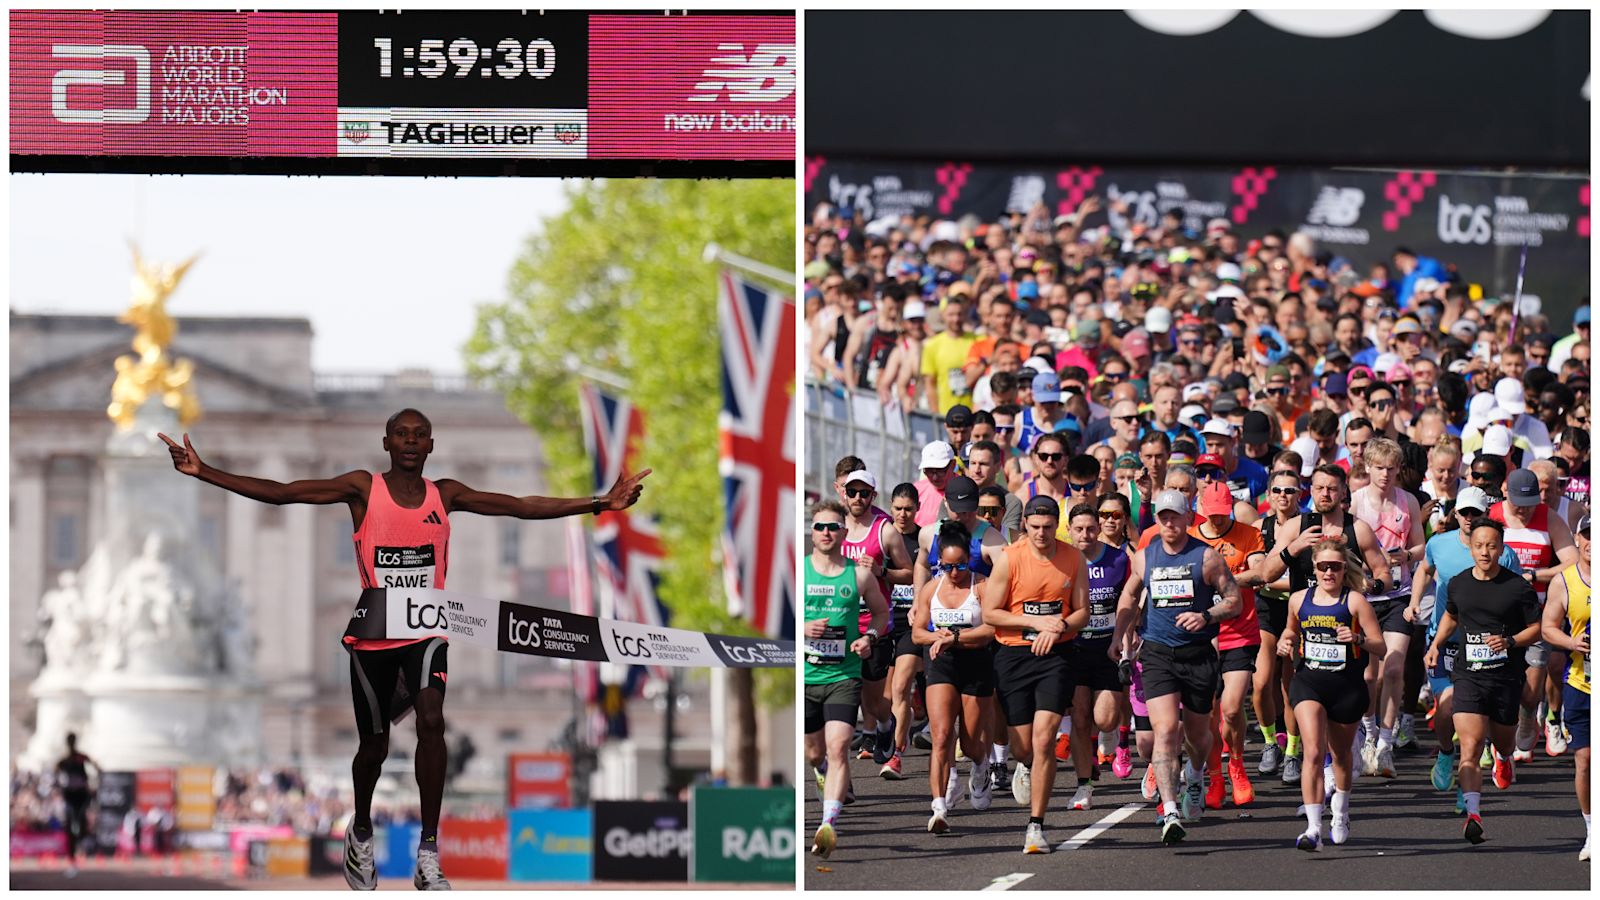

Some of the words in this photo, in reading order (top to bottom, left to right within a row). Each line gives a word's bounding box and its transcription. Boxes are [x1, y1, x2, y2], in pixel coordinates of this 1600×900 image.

[163, 45, 249, 63] ABBOTT
[374, 37, 556, 79] 1:59:30
[162, 66, 244, 84] WORLD
[162, 87, 287, 105] MARATHON
[162, 107, 249, 125] MAJORS
[664, 114, 715, 132] new
[720, 110, 796, 132] balan
[377, 549, 401, 565] tcs
[384, 574, 428, 588] SAWE
[808, 586, 834, 594] Justin
[1157, 584, 1186, 595] 53784
[407, 597, 448, 629] tcs
[447, 600, 465, 612] TATA
[448, 612, 487, 628] CONSULTANCY
[542, 617, 562, 629] TATA
[938, 612, 965, 623] 53854
[451, 623, 474, 637] SERVICES
[509, 611, 541, 648] tcs
[542, 629, 590, 643] CONSULTANCY
[612, 628, 651, 658] tcs
[647, 633, 669, 643] TATA
[1466, 632, 1481, 643] tcs
[544, 640, 576, 652] SERVICES
[651, 643, 700, 654] CONSULTANCY
[720, 640, 767, 663] tcs
[809, 641, 838, 653] 54314
[1310, 646, 1339, 659] 52769
[655, 652, 690, 661] SERVICES
